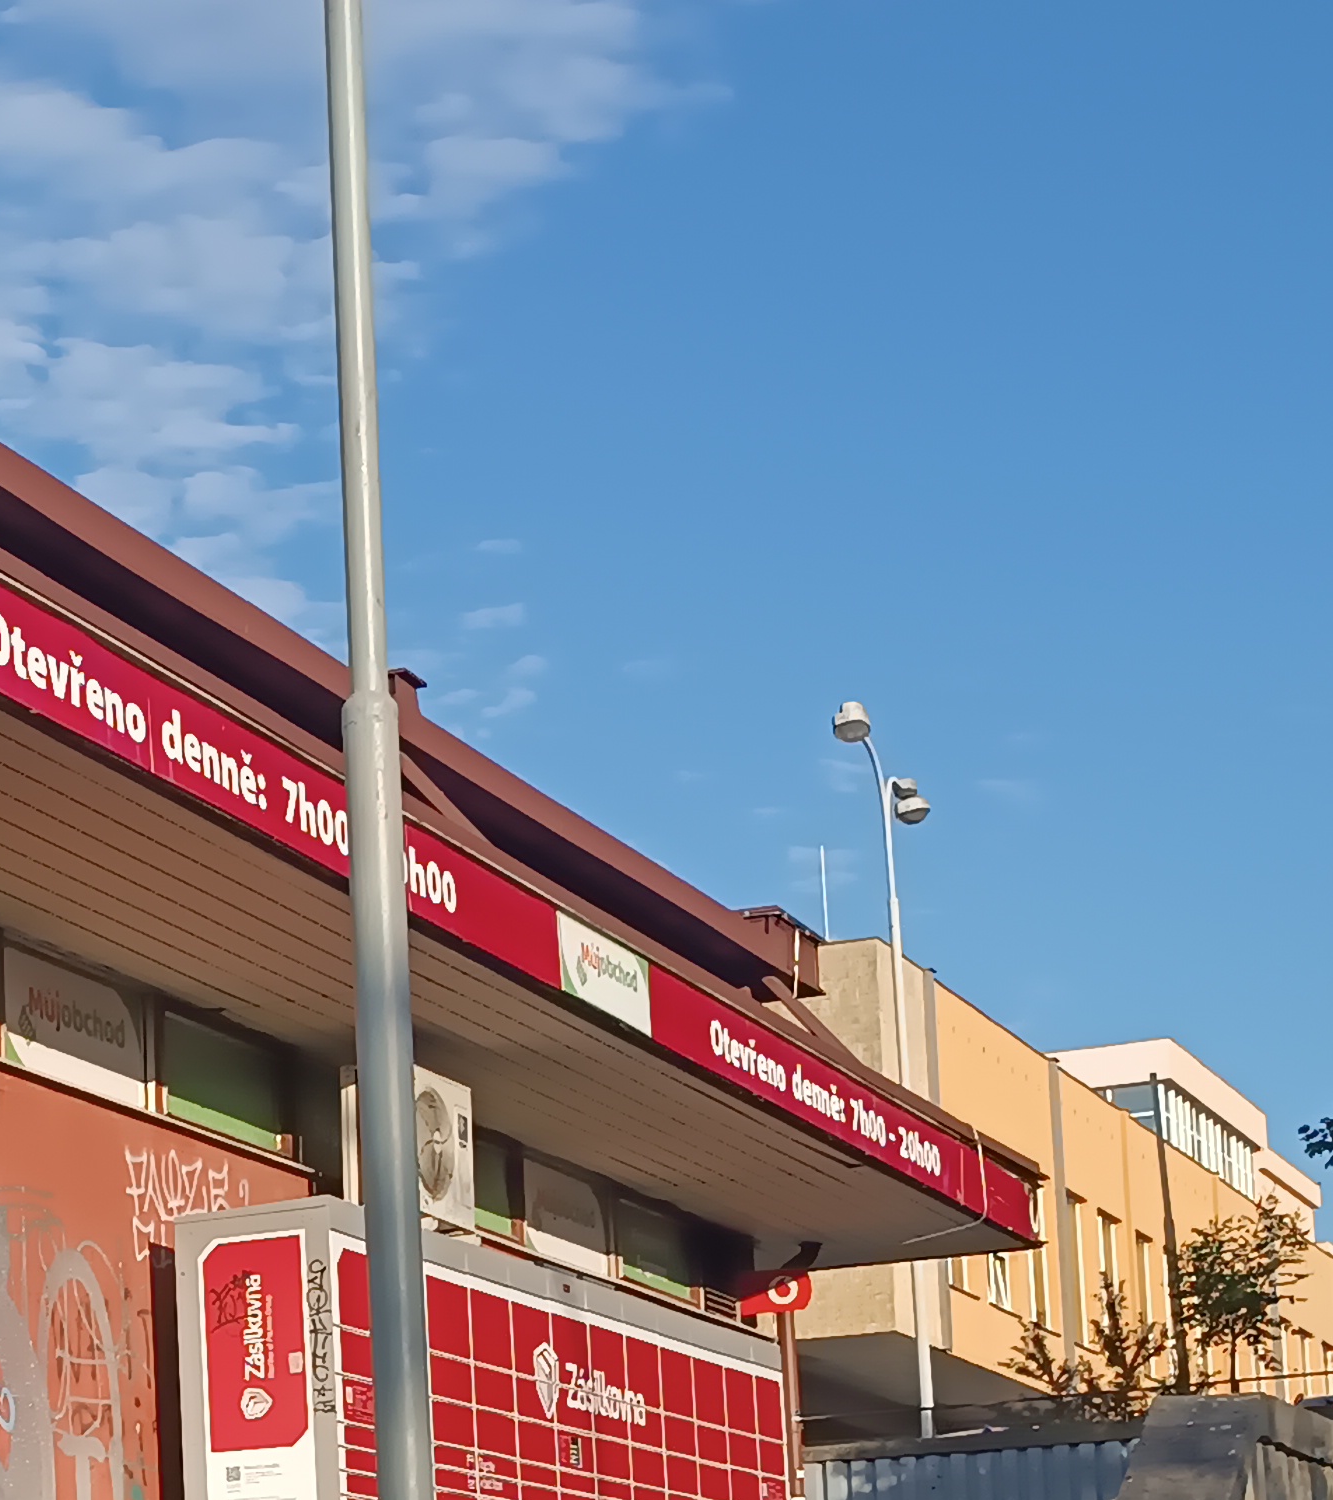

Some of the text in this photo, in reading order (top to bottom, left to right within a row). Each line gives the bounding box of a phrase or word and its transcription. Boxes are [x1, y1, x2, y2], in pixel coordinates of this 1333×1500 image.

[162, 709, 268, 810] denně:
[282, 776, 349, 856] 7h00
[709, 1020, 787, 1092] Otevřeno
[792, 1063, 846, 1123] denně:
[850, 1098, 887, 1147] 7h00
[898, 1126, 942, 1177] 20h00
[242, 1274, 266, 1382] Zásilkovna
[564, 1362, 647, 1427] Zásilkovna
